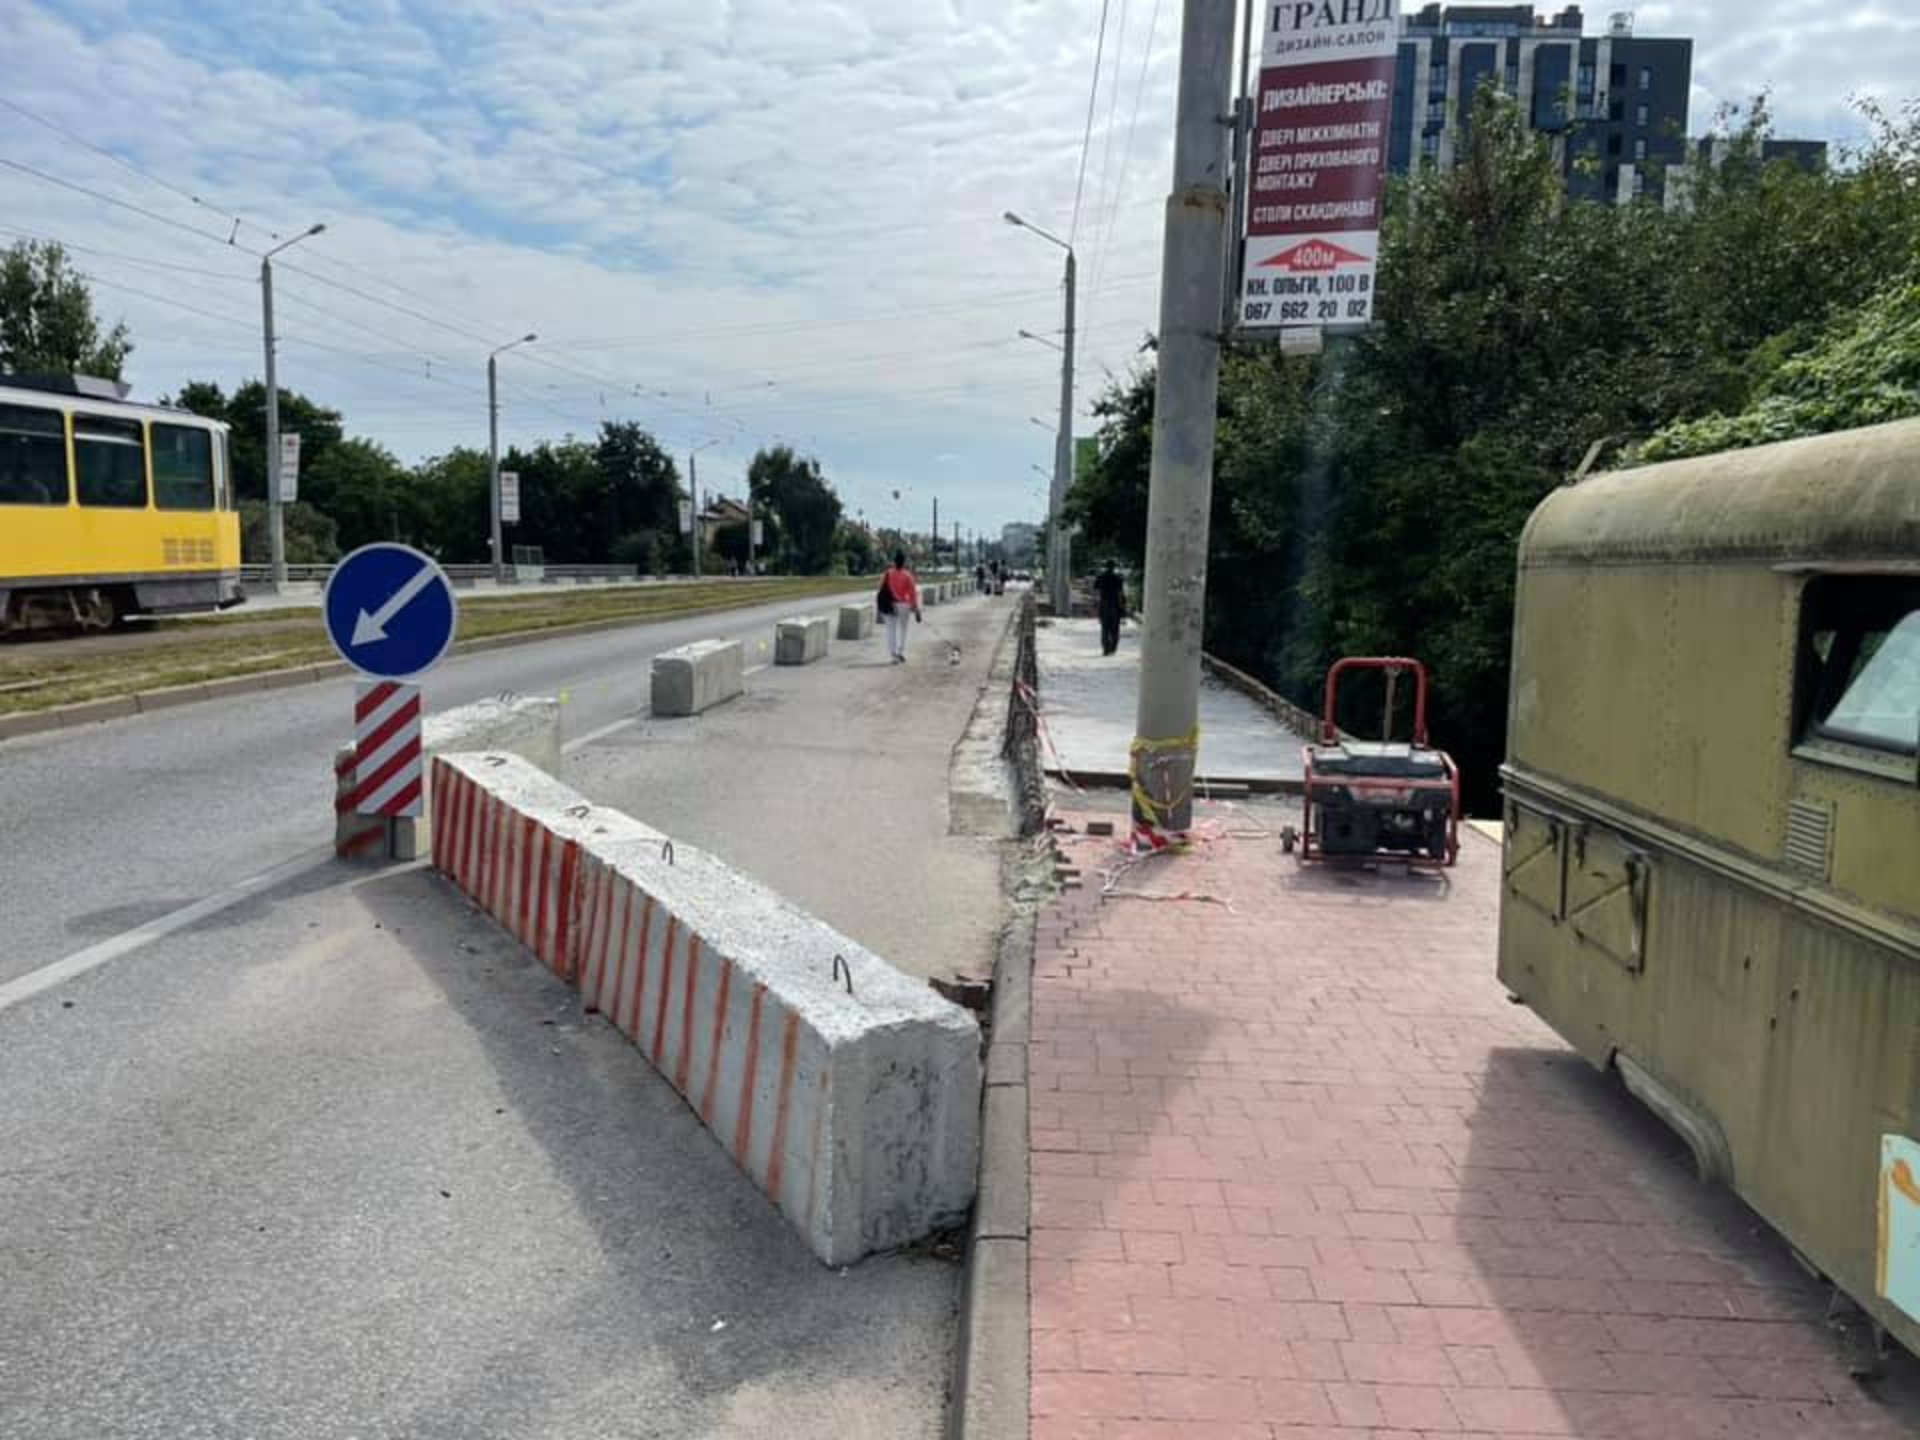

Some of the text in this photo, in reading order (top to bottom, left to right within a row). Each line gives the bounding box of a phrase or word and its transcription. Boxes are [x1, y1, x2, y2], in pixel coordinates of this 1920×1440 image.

[1271, 0, 1393, 32] ГРАНД
[1276, 31, 1385, 54] ДИЗАЙН-САЛОН
[1328, 274, 1355, 292] 100
[1359, 273, 1370, 291] В
[1245, 299, 1367, 320] 067 662 20 02
